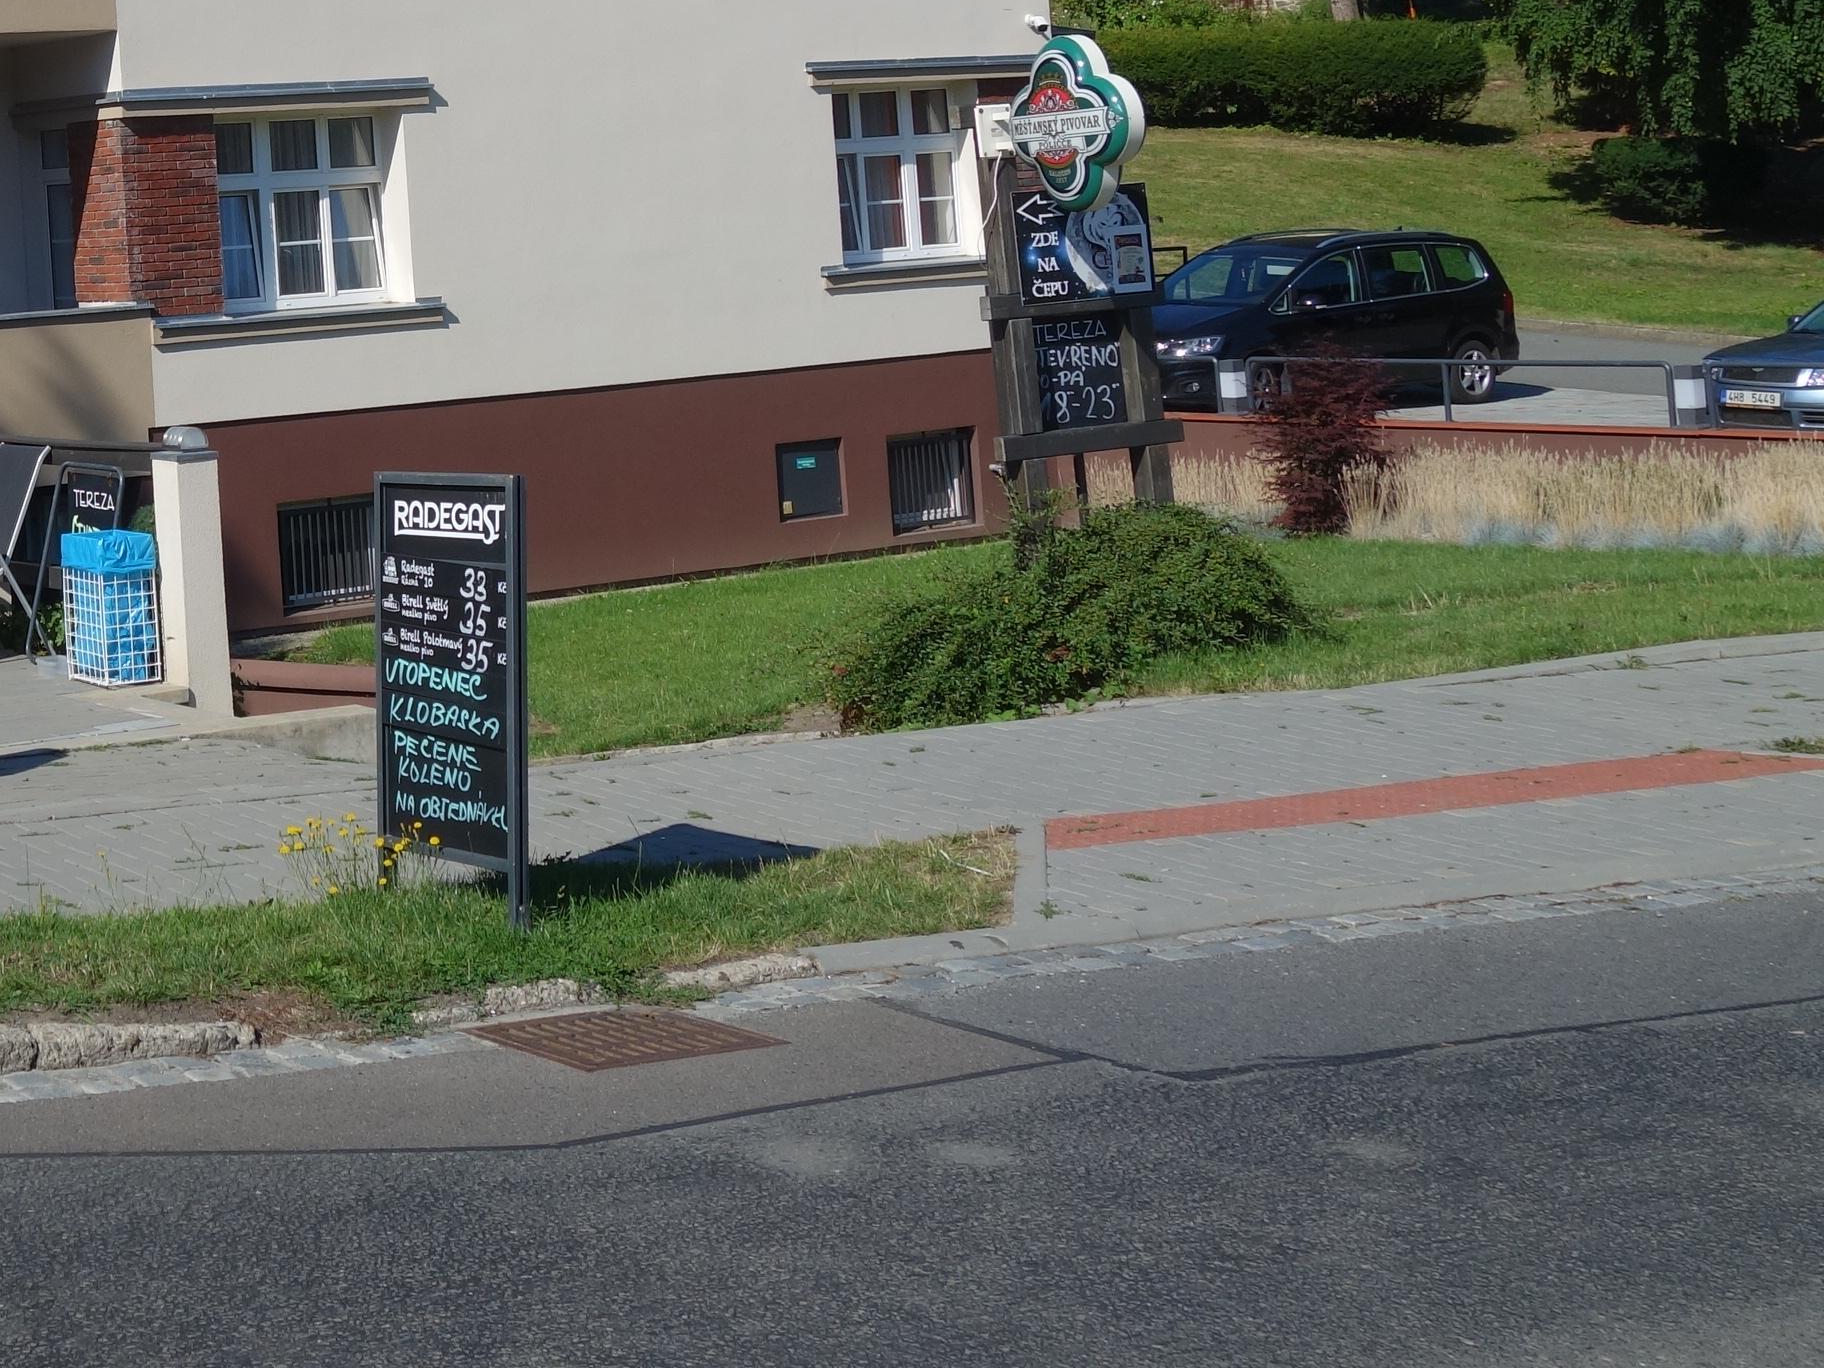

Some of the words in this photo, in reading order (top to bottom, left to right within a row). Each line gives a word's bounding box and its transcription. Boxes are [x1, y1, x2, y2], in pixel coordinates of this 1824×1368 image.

[1061, 114, 1102, 133] PIVOVAR
[1031, 231, 1060, 247] ZDE
[1037, 256, 1061, 272] NA
[1032, 279, 1069, 298] ČEPU
[1032, 320, 1107, 344] TEREZA
[1751, 393, 1777, 405] 5449
[73, 489, 115, 511] TEREZA
[394, 499, 506, 545] RADEGAST
[401, 559, 435, 580] Radegast
[424, 576, 434, 588] 10
[459, 568, 487, 602] 33
[497, 581, 507, 594] Kč
[401, 608, 423, 619] nealko
[424, 612, 437, 625] pivo
[402, 594, 424, 609] Birell
[425, 597, 449, 620] Světlý
[459, 601, 491, 637] 35
[497, 617, 507, 629] Kč
[399, 642, 420, 654] nealko
[420, 646, 434, 660] pivo
[400, 628, 421, 643] Birell
[423, 631, 463, 658] Polotmavý
[461, 639, 494, 673] 35
[497, 653, 507, 666] Kč
[385, 658, 488, 701] UTOPENEC
[398, 755, 472, 792] KOLENO
[395, 790, 415, 816] NA
